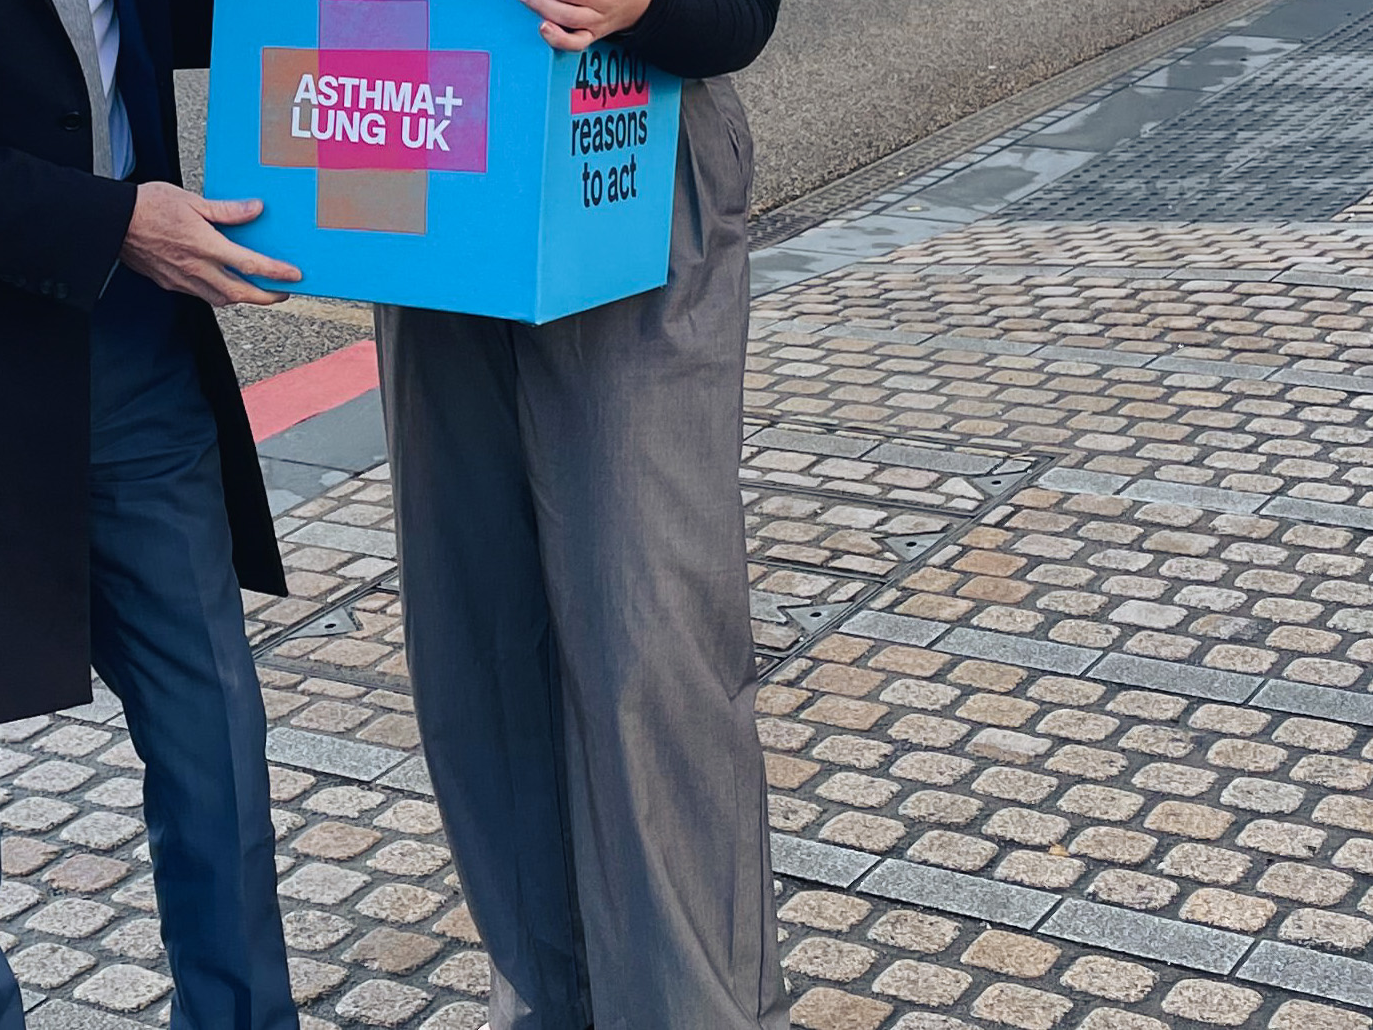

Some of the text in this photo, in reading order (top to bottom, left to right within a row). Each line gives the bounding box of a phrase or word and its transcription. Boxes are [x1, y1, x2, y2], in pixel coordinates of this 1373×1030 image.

[294, 73, 463, 117] ASTHMA+
[575, 49, 647, 108] 43,000
[291, 106, 451, 151] LUNG UK
[571, 110, 647, 157] reasons
[582, 154, 637, 208] to act
